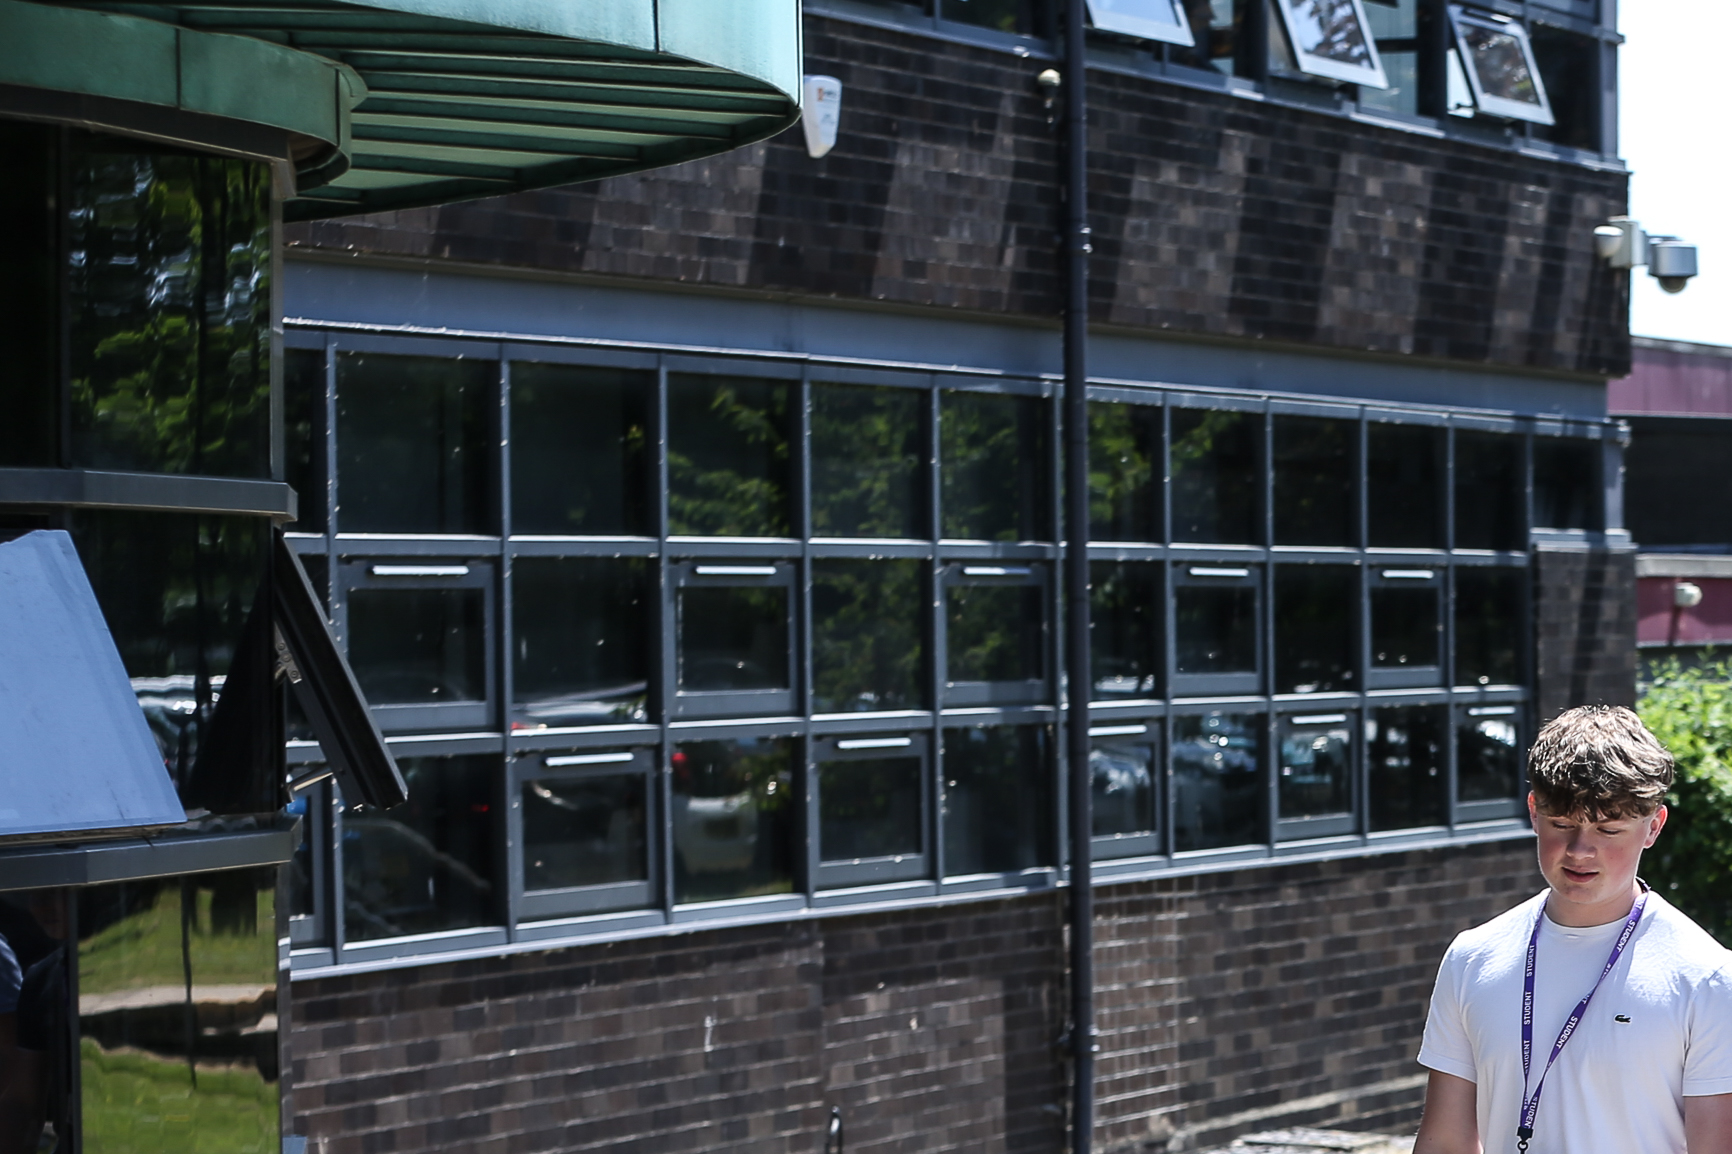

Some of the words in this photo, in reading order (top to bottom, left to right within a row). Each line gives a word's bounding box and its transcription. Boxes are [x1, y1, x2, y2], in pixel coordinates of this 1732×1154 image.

[1616, 920, 1636, 952] STUDENT
[1526, 944, 1535, 978] STUDENT
[1524, 991, 1532, 1025] STUDENT
[1556, 1015, 1580, 1049] STUDENT
[1524, 1096, 1538, 1128] STUDEN
